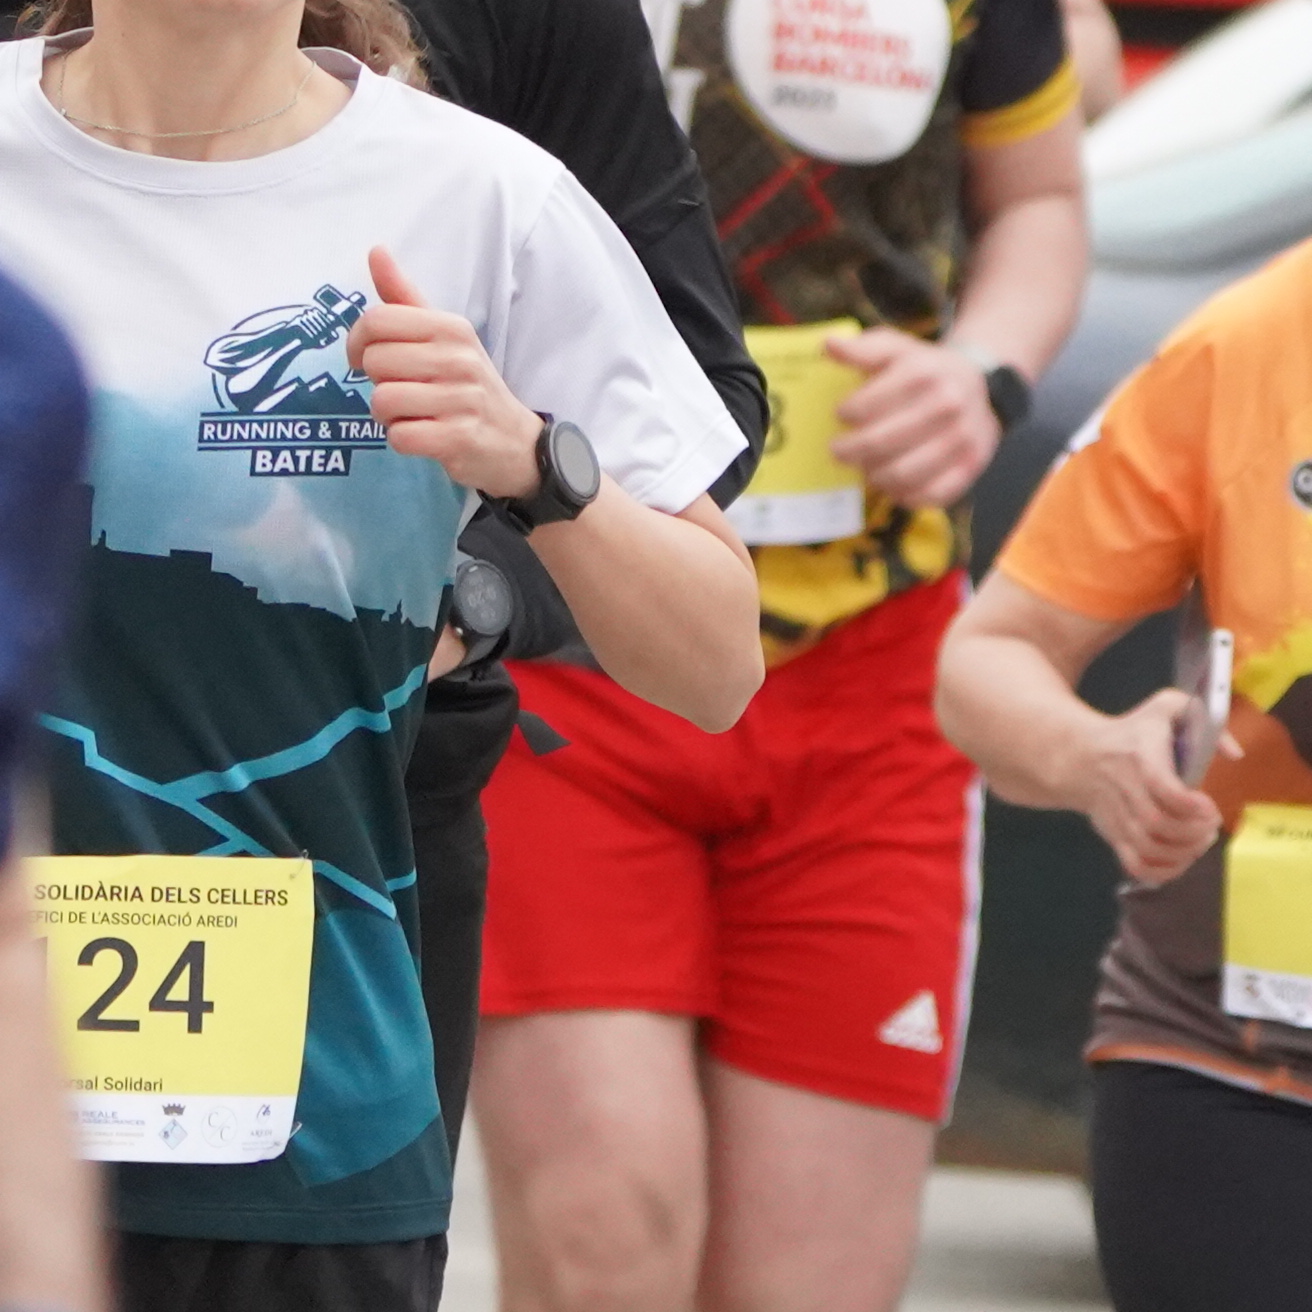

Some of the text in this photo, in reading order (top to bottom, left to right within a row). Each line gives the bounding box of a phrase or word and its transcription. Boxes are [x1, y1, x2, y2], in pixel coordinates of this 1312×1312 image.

[202, 421, 387, 440] RUNNING & TRAIL
[254, 449, 346, 474] BATEA
[34, 880, 289, 907] SOLIDÀRIA DELS CELLERS
[68, 911, 87, 925] DE
[196, 915, 238, 929] AREDI
[37, 936, 216, 1035] 24
[103, 1076, 163, 1093] Solidari
